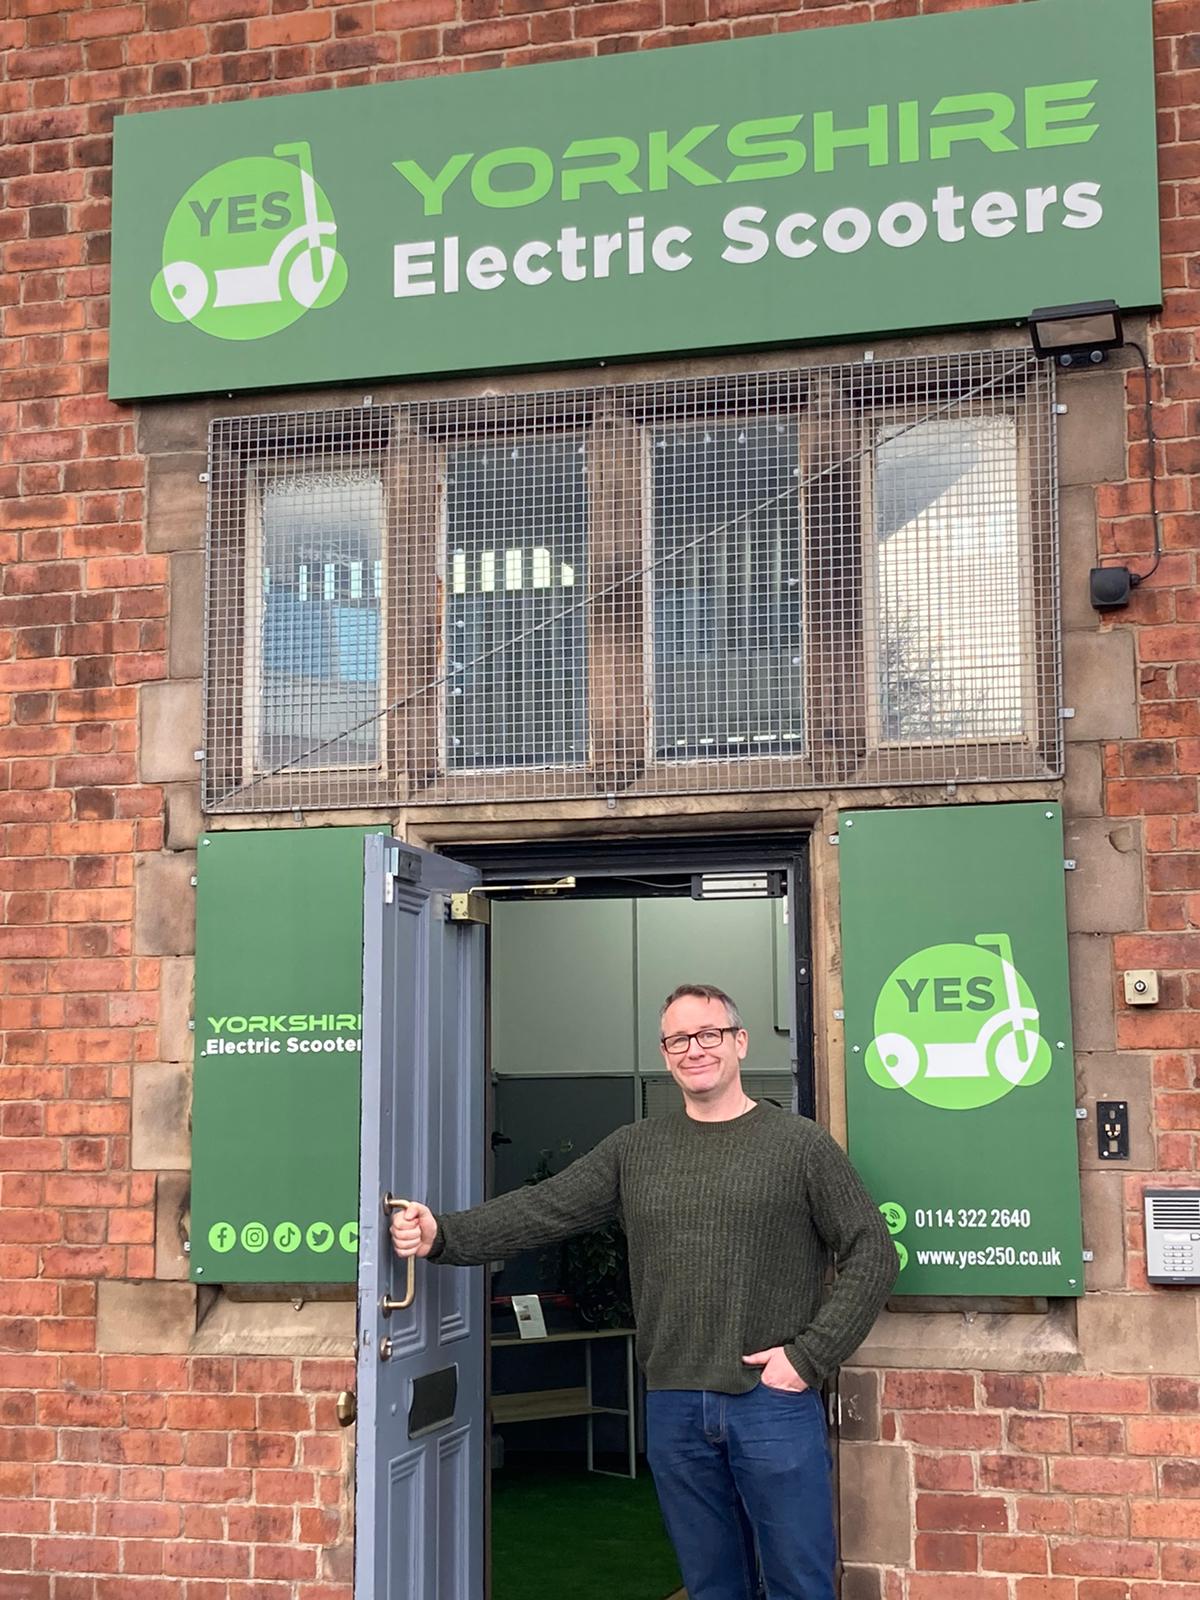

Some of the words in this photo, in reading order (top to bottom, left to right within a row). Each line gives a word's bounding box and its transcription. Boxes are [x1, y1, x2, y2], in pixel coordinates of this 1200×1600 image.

[393, 79, 1099, 216] YORKSHIRE
[188, 190, 292, 237] YES
[393, 216, 693, 298] Electric
[721, 181, 1103, 264] Scooters
[895, 976, 996, 1013] YES
[207, 1014, 361, 1034] YORKSHIR
[206, 1037, 281, 1055] Electric
[915, 1208, 955, 1228] 0114
[957, 1208, 988, 1228] 322
[990, 1208, 1031, 1228] 2640
[916, 1246, 1062, 1270] www.yes250.co.uk
